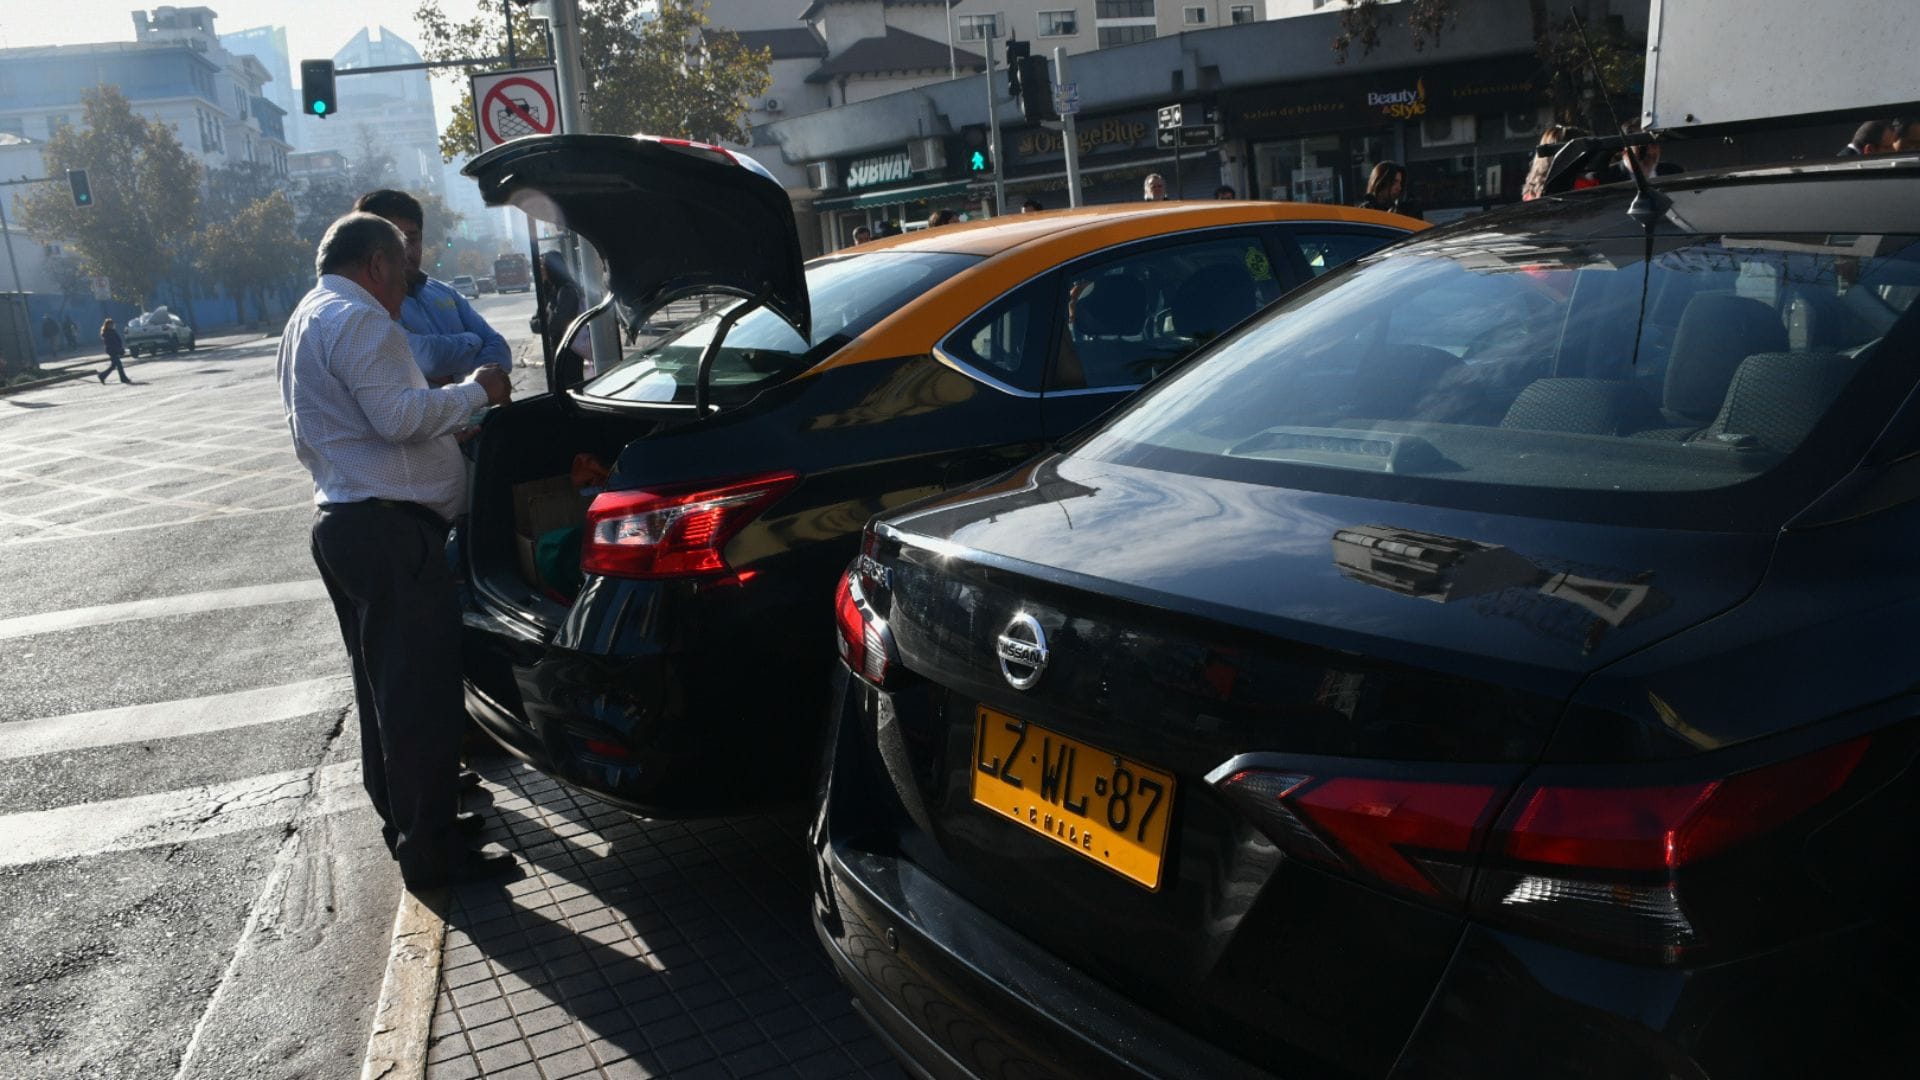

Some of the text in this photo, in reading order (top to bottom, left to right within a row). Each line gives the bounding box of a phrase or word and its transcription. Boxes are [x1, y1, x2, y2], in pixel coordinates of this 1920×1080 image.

[1368, 89, 1417, 105] Beauty
[1391, 101, 1426, 119] Style
[847, 155, 912, 188] SUBWAY
[999, 641, 1041, 663] NISSAN
[1029, 805, 1093, 850] CHILE
